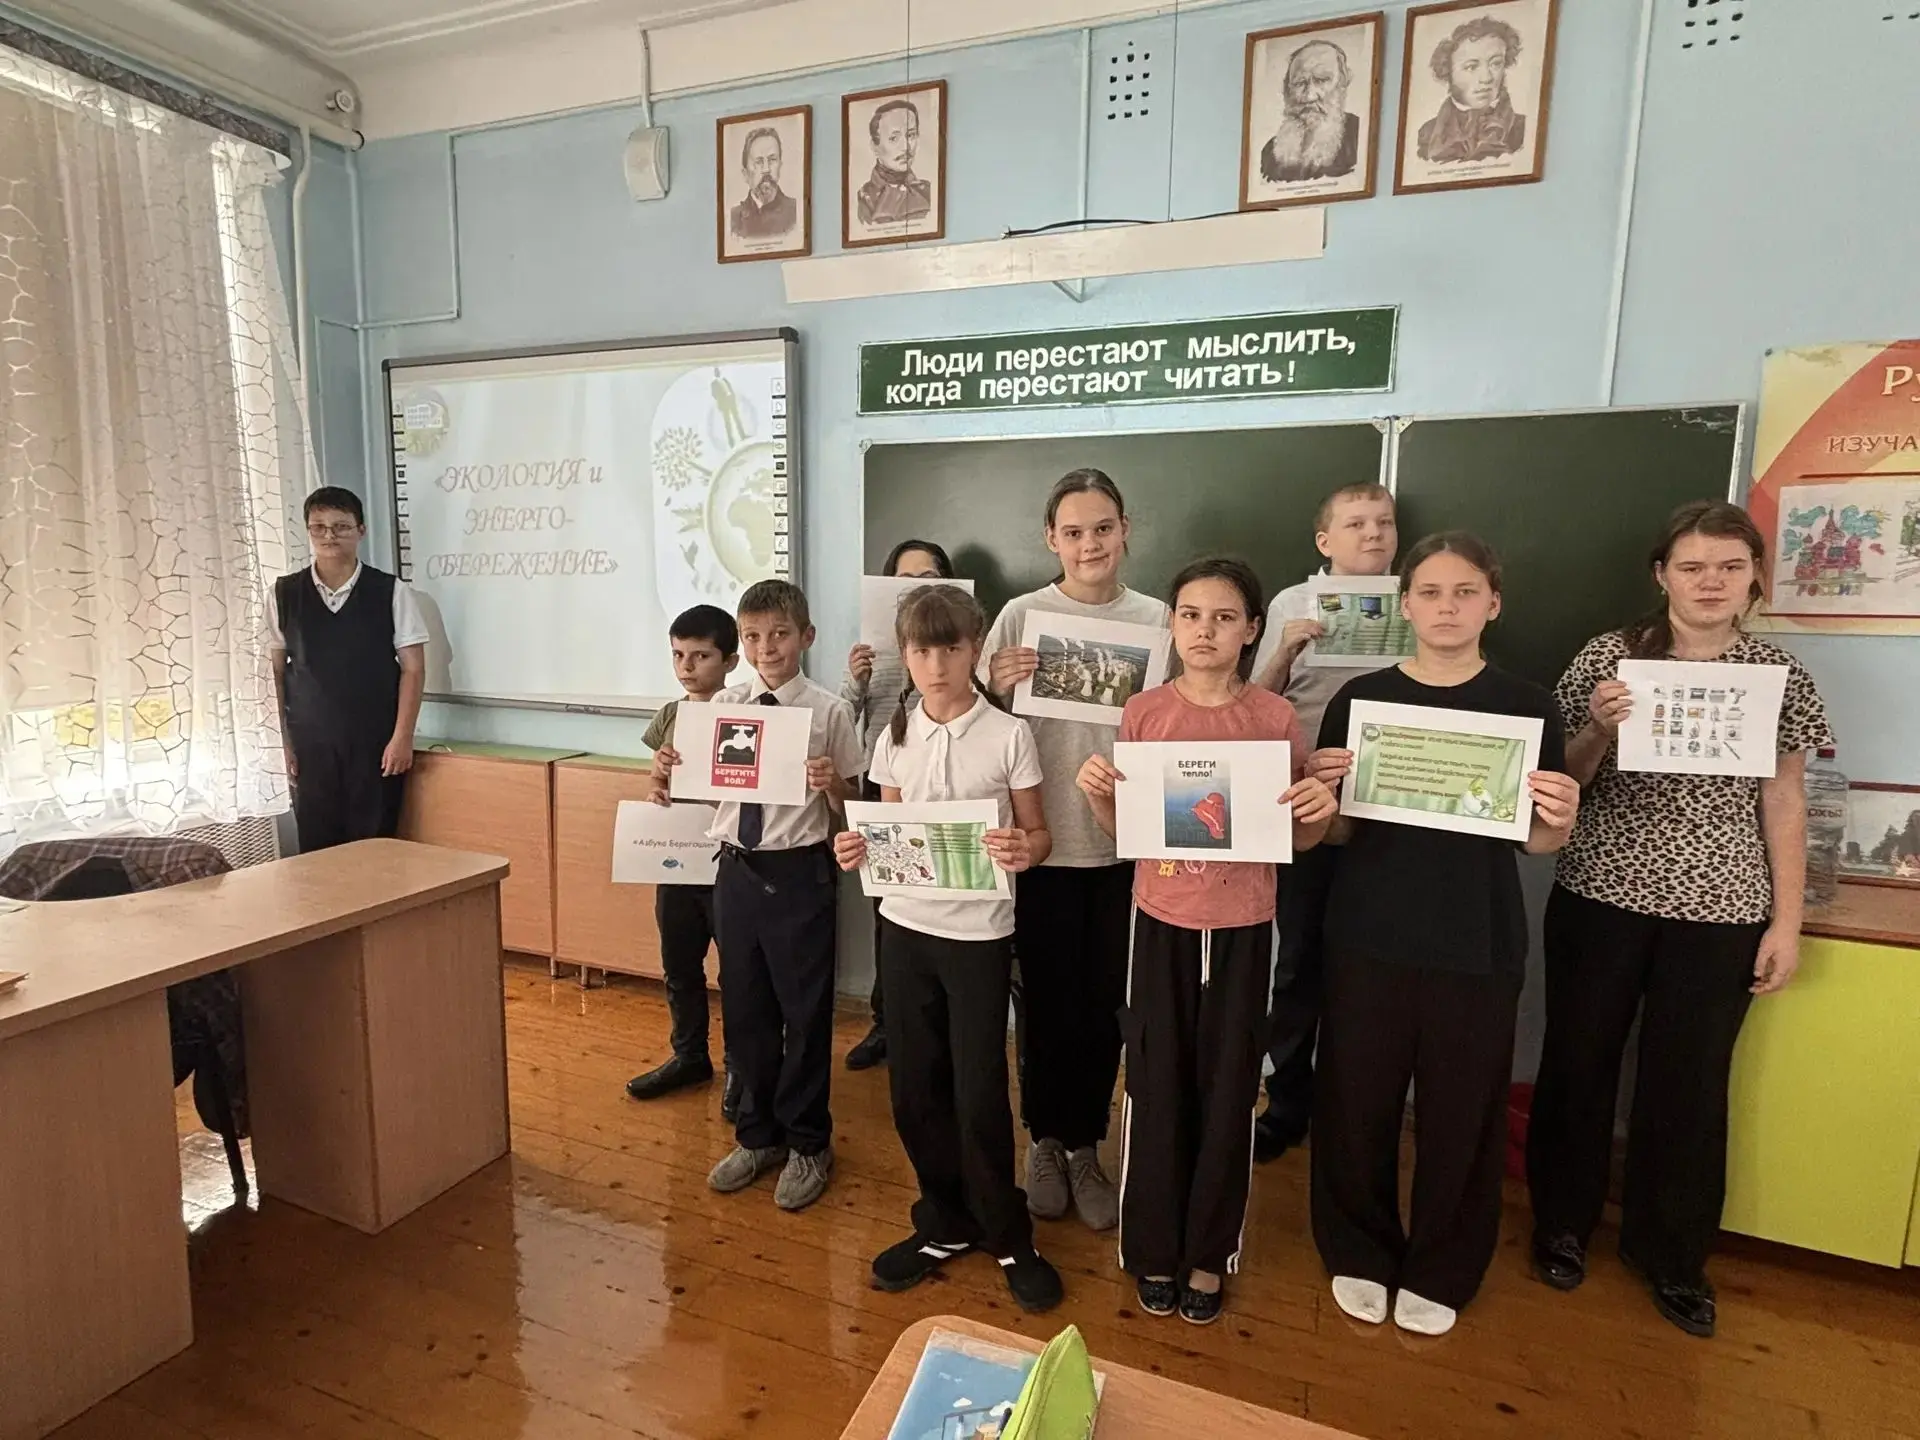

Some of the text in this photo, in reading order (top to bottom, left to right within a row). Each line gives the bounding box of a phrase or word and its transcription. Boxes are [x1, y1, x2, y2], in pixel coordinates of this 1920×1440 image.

[901, 328, 1356, 377] Люди перестают мыслить,
[886, 380, 962, 406] когда
[979, 370, 1148, 404] перестают
[434, 457, 603, 494] «ЭКОЛОГИЯ и
[462, 506, 575, 536] ЭНЕРГО-
[425, 549, 619, 580] СБЕРЕЖЕНИЕ»
[714, 767, 756, 777] БЕРЕГИТЕ
[1178, 760, 1217, 769] БЕРЕГИ
[1182, 770, 1213, 778] тепло!
